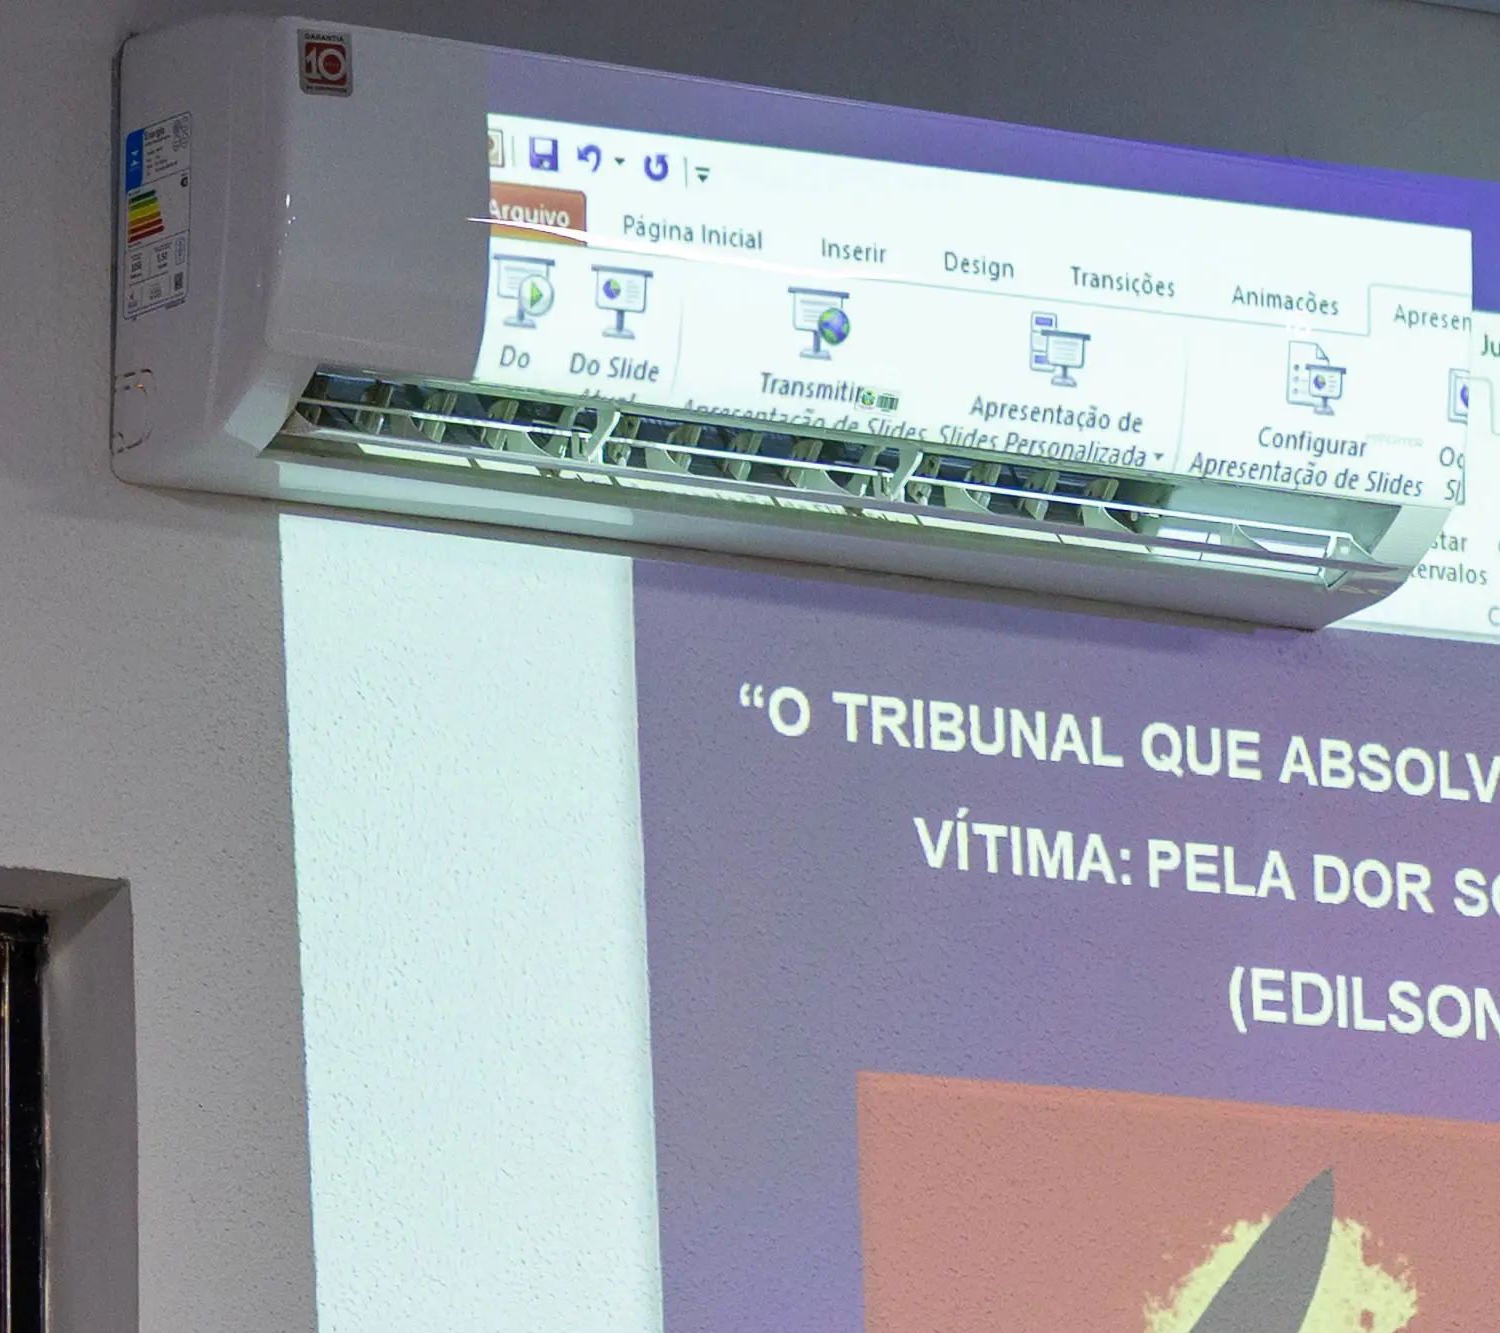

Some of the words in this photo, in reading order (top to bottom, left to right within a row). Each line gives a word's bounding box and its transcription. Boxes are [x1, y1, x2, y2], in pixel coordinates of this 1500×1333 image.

[304, 46, 347, 81] 10
[622, 213, 695, 244] Página
[701, 224, 763, 250] Inicial
[821, 237, 887, 263] Inserir
[943, 251, 1015, 281] Design
[1070, 265, 1176, 298] Transições
[500, 345, 531, 369] Do
[569, 352, 600, 377] Do
[607, 355, 660, 384] Slide
[969, 395, 1111, 432] Apresentação
[1117, 412, 1143, 434] de
[939, 424, 1000, 450] Slides
[1004, 431, 1147, 468] Personalizada
[1257, 425, 1368, 460] Configurar
[1188, 451, 1328, 491] Apresentação
[1334, 465, 1361, 490] de
[1365, 470, 1424, 498] Slides
[738, 682, 811, 739] “O
[832, 690, 1124, 771] TRIBUNAL
[1140, 721, 1262, 783] QUE
[913, 806, 1133, 887] VÍTIMA:
[1147, 841, 1297, 901] PELA
[1313, 852, 1435, 914] DOR
